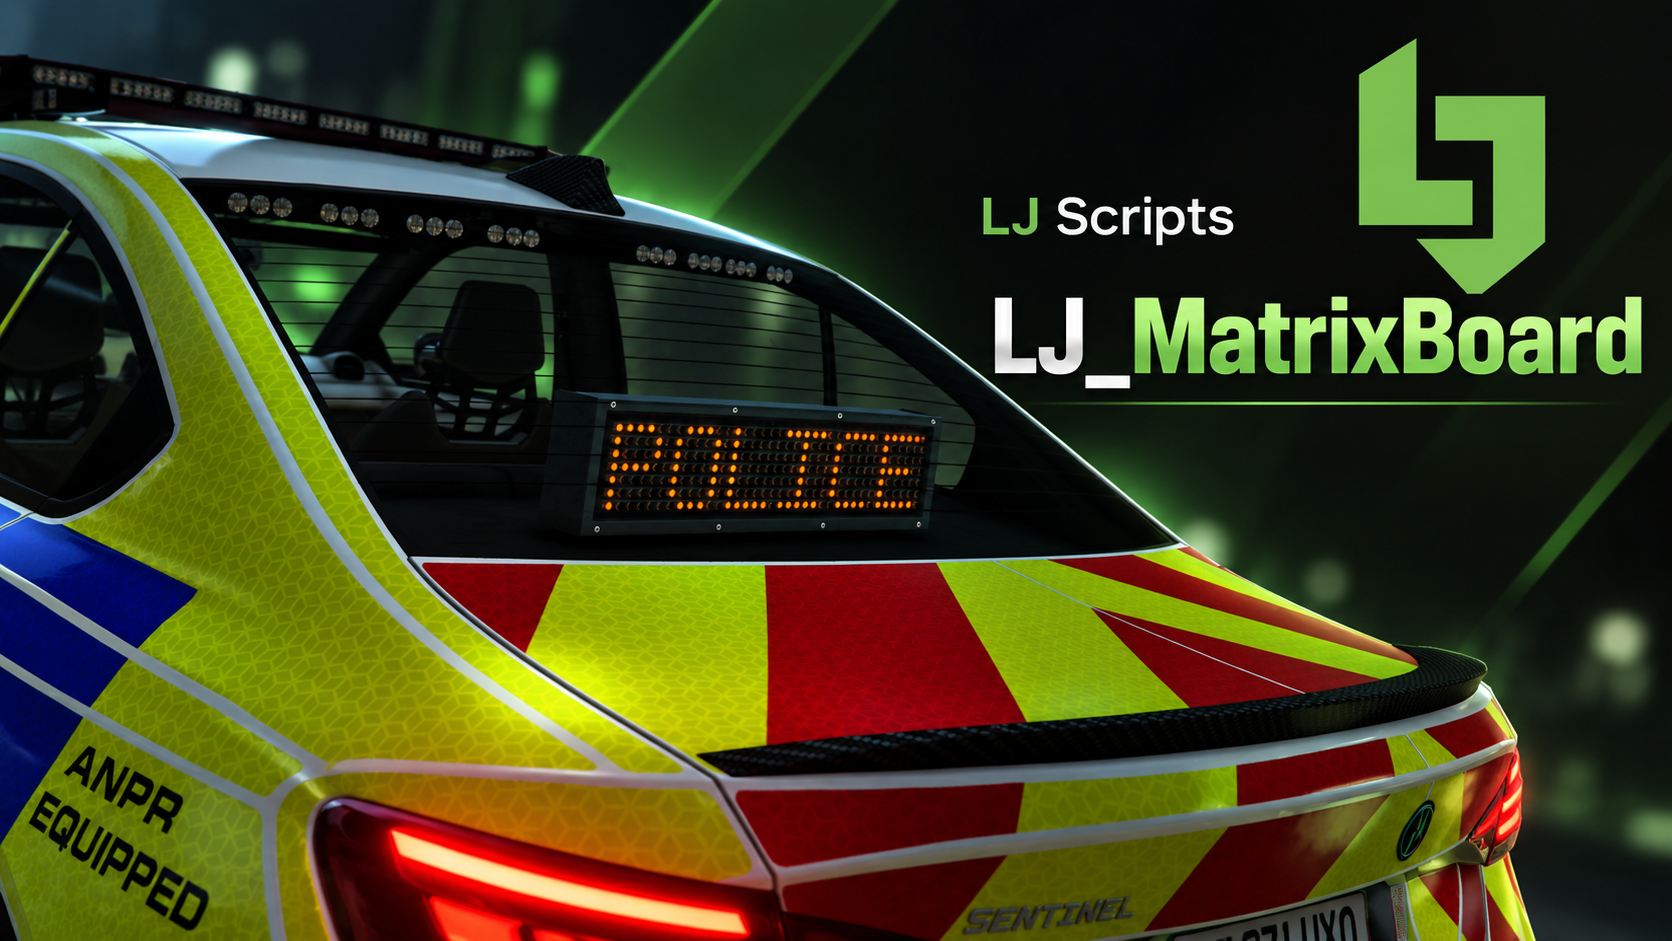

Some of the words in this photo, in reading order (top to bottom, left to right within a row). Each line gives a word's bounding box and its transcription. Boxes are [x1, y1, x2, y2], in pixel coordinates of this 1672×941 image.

[603, 423, 926, 511] POLICE
[64, 745, 184, 834] ANPR
[28, 791, 209, 931] EQUIPPED
[963, 896, 1135, 935] SENTINEL
